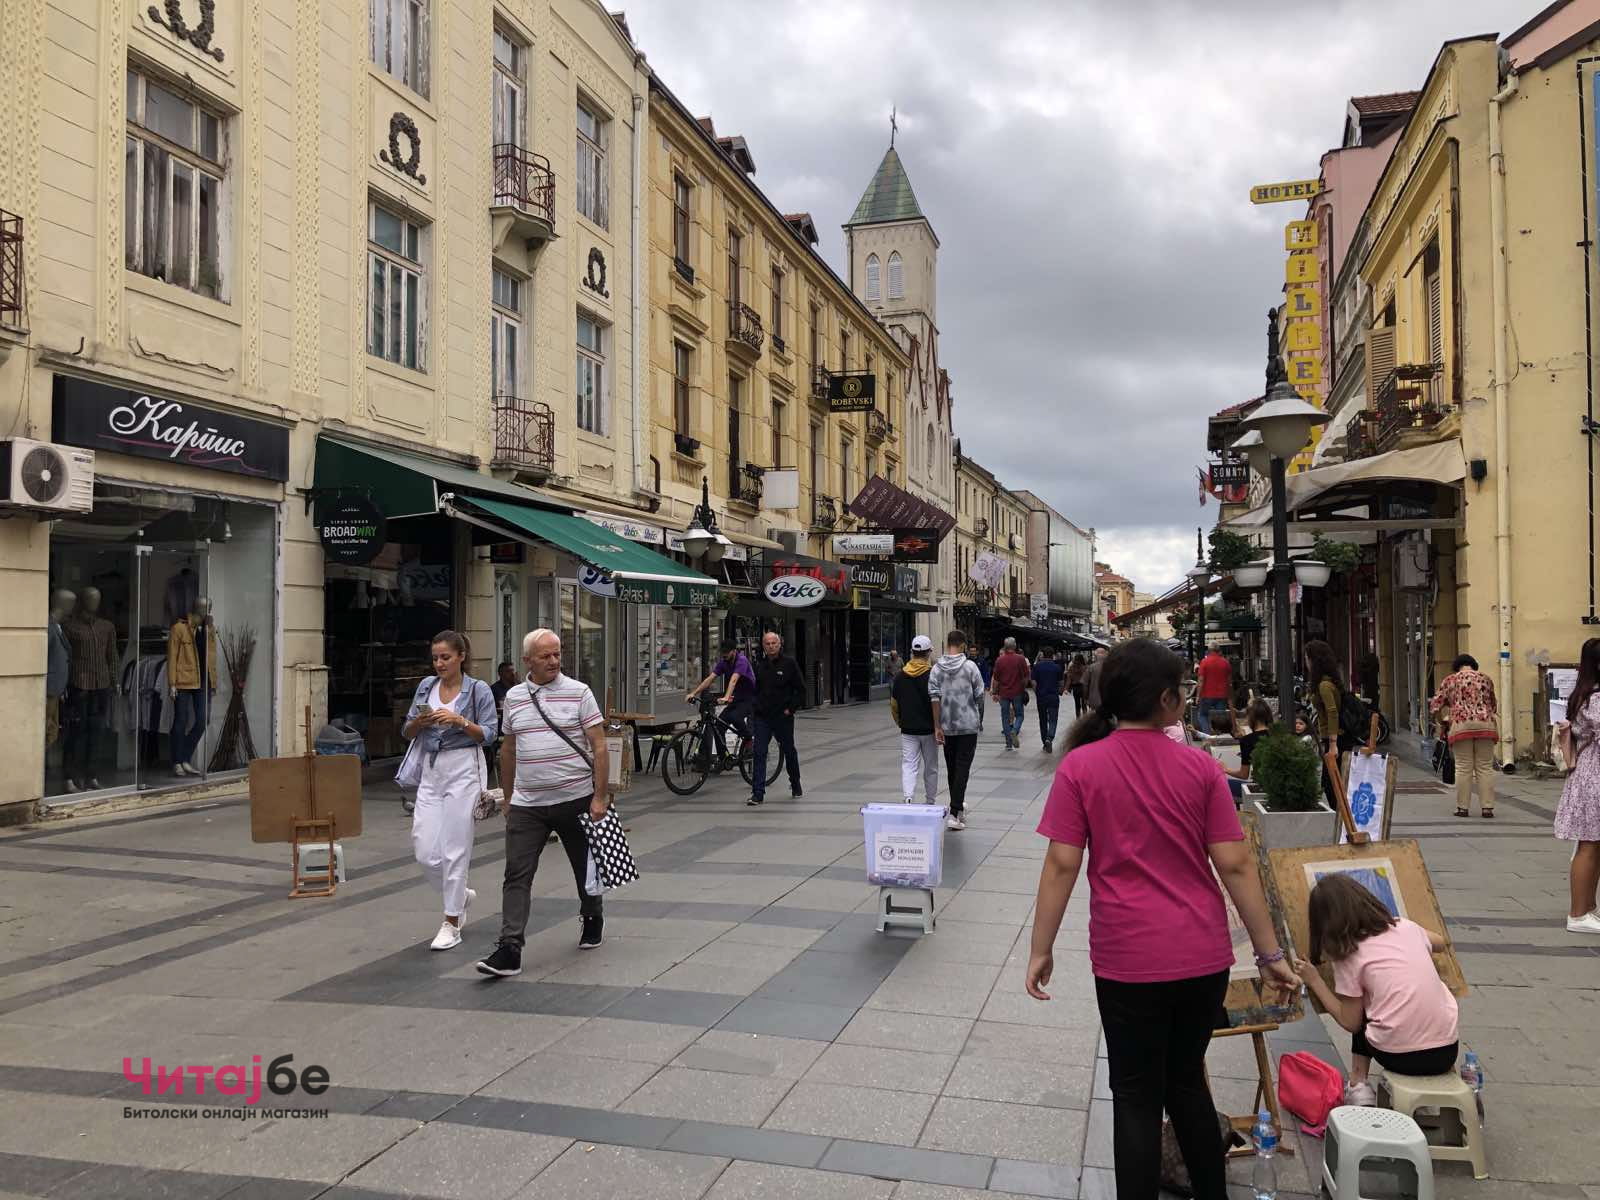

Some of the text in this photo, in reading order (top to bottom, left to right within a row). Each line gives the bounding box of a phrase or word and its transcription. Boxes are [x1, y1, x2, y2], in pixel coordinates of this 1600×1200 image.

[1257, 182, 1315, 201] HOTEL
[831, 397, 873, 406] ROBEVSKI
[323, 525, 377, 538] BROADWAY
[850, 564, 889, 587] Casino
[769, 581, 822, 598] Peko
